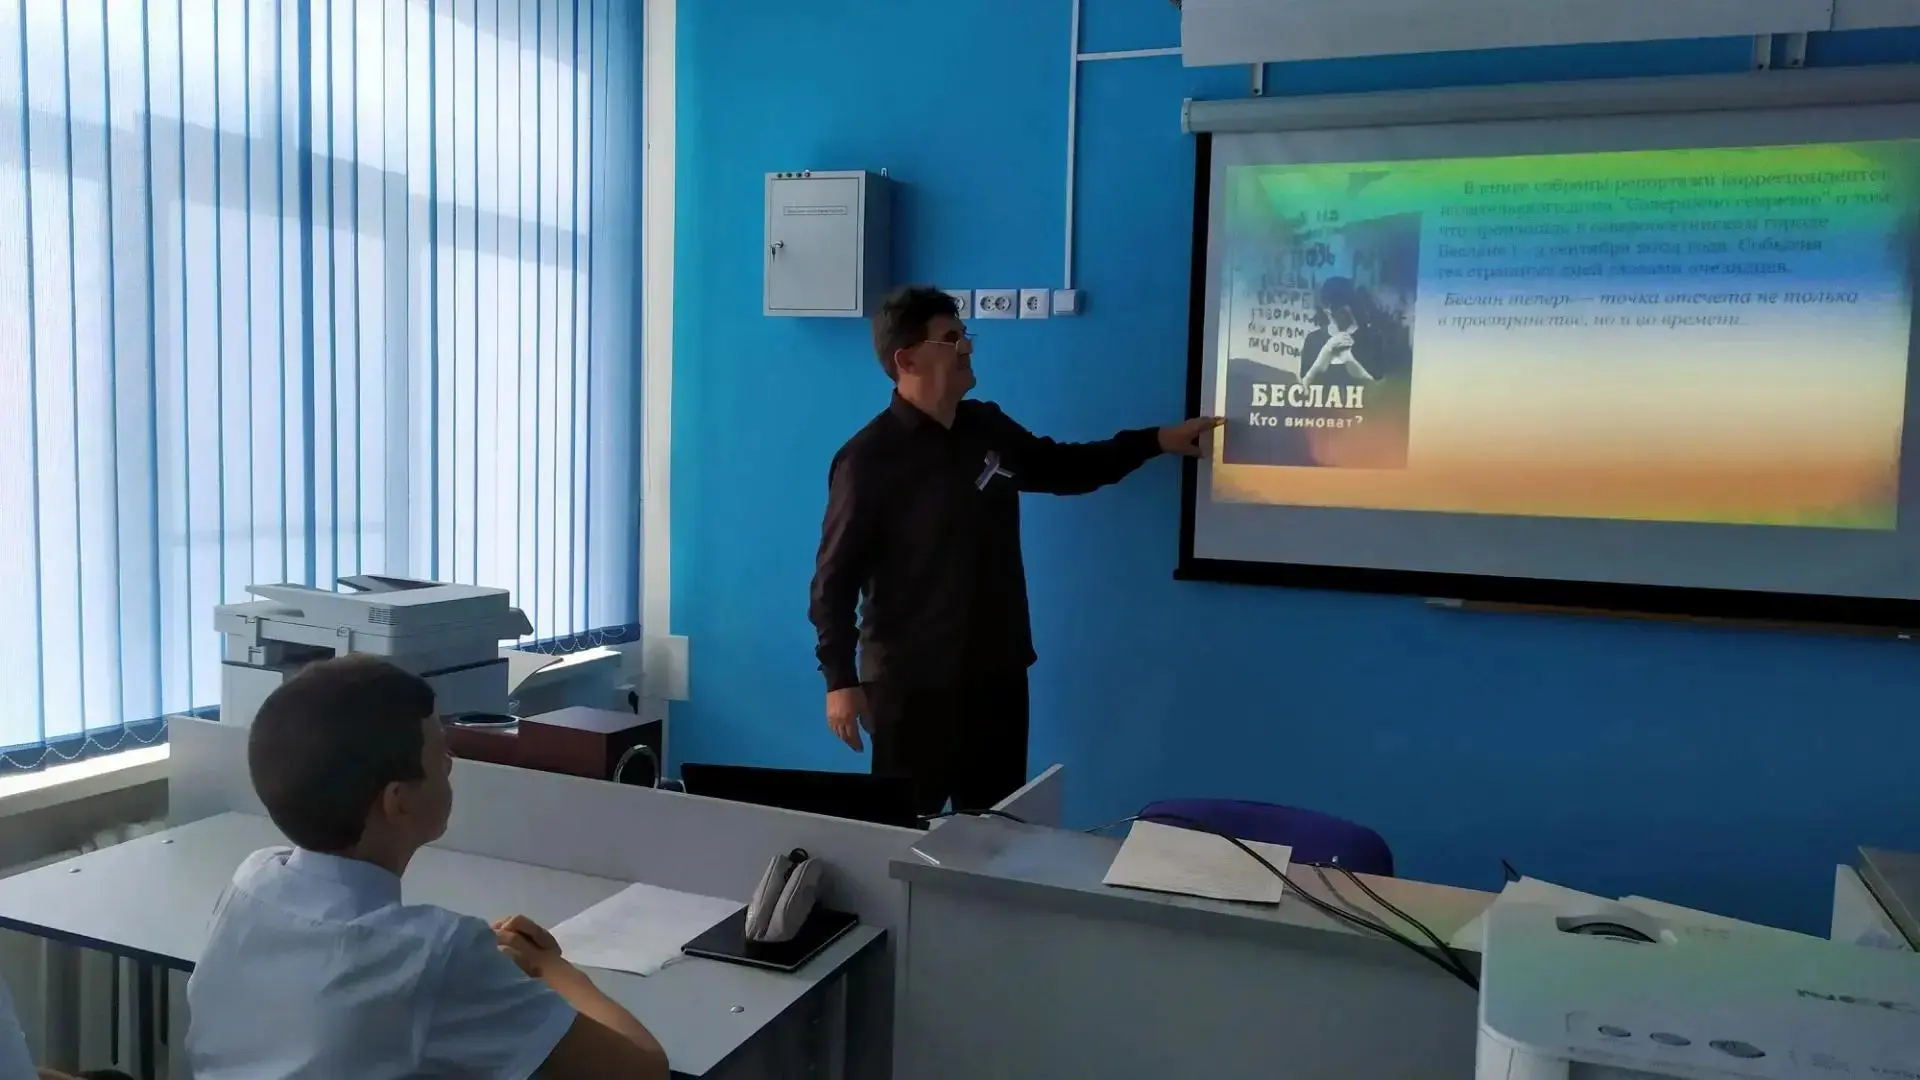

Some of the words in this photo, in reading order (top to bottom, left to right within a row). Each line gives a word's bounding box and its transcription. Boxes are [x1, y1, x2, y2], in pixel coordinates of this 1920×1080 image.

[1444, 292, 1504, 306] Беслан
[1251, 384, 1365, 408] БЕСЛАН
[1249, 412, 1278, 427] Кто
[1285, 416, 1364, 428] виноват?
